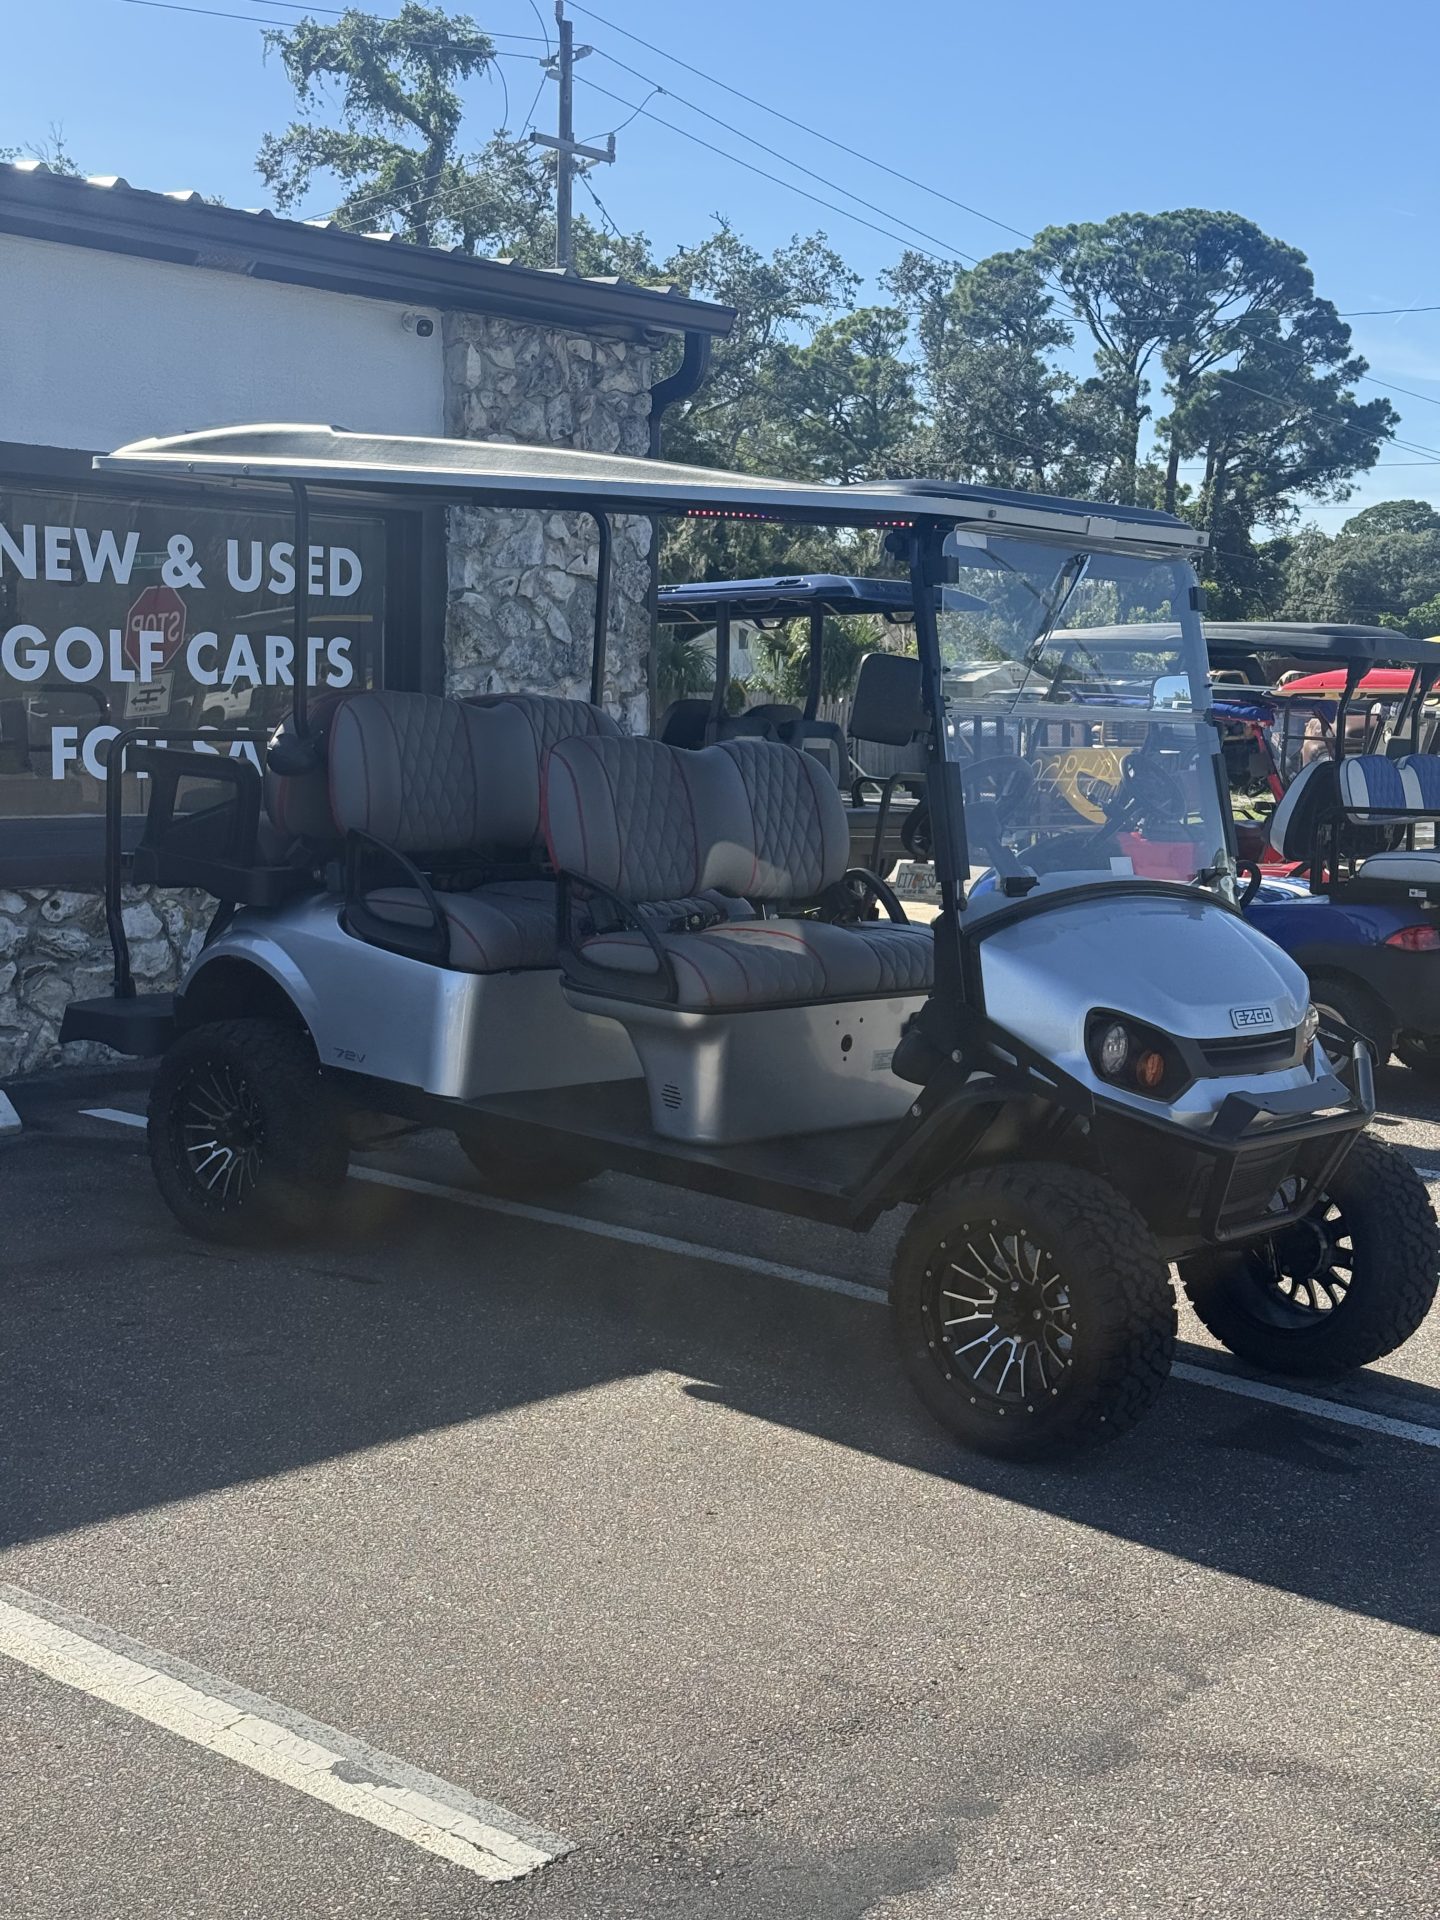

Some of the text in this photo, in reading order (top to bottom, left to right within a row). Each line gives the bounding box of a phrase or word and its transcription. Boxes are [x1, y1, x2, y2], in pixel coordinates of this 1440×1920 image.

[0, 523, 362, 597] NEW & USED
[1, 624, 353, 688] GOLF CARTS
[333, 1047, 366, 1063] 72V
